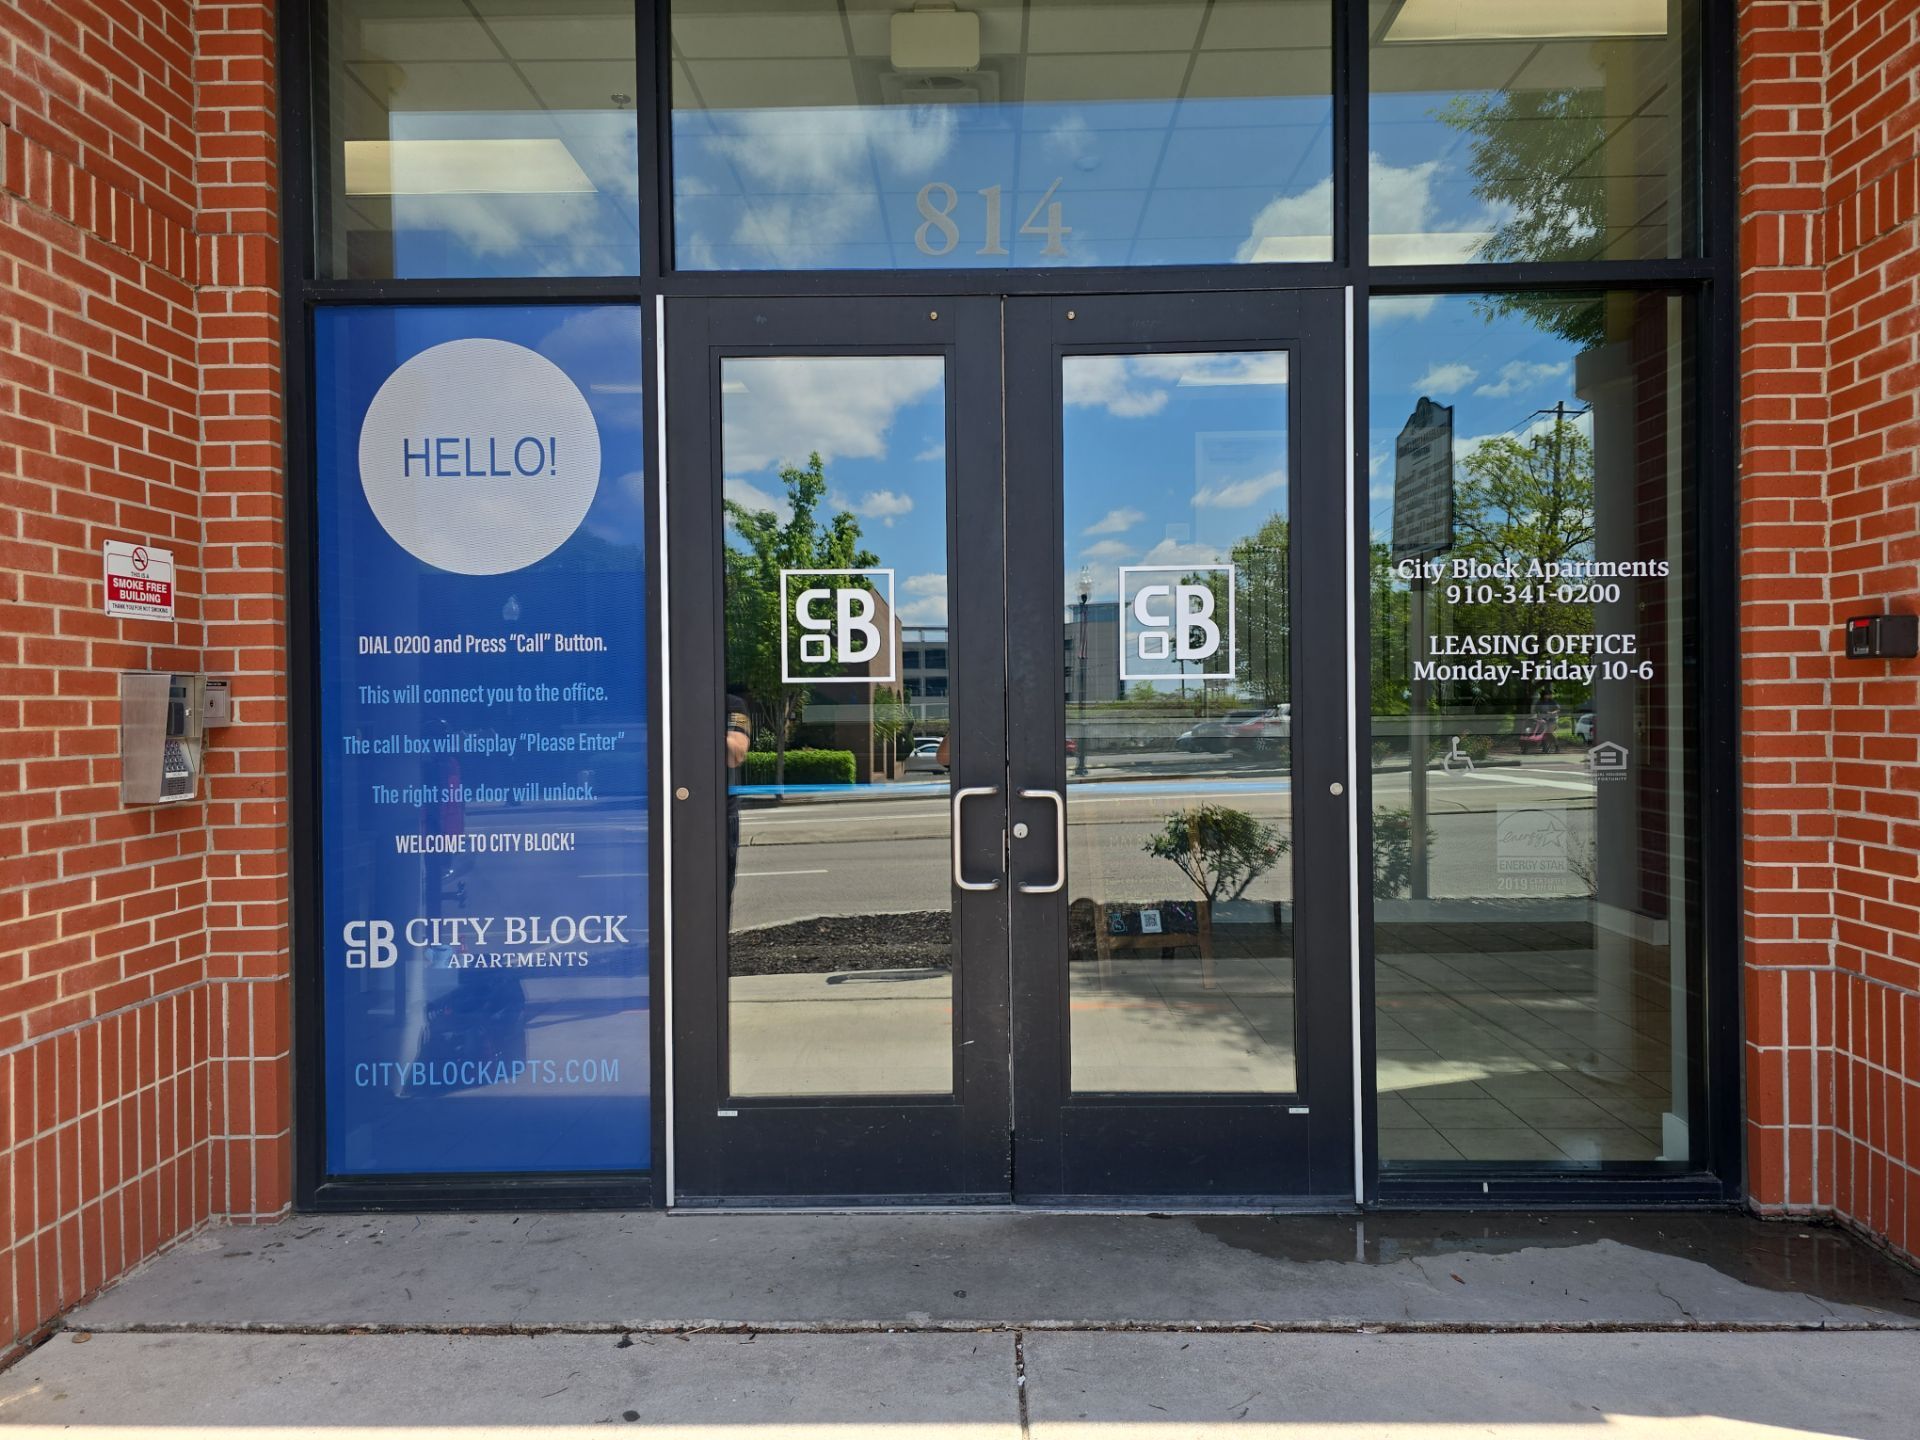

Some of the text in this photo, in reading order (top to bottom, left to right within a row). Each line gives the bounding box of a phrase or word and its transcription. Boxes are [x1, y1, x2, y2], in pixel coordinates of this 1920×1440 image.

[914, 176, 1072, 256] 814
[403, 436, 556, 478] HELLO!
[1400, 558, 1670, 583] City Block Apartments
[113, 577, 167, 594] SMOKE FREE
[120, 589, 161, 603] BUILDING
[1446, 584, 1620, 604] 910-341-0200
[359, 636, 391, 655] DIAL
[394, 635, 430, 654] 0200
[434, 634, 462, 653] and
[465, 634, 506, 653] Press
[555, 633, 607, 652] Button.
[1429, 634, 1637, 656] LEASING OFFICE
[1413, 659, 1654, 685] Monday-Friday 10-6
[358, 682, 608, 707] This will connect you to the office.
[343, 736, 370, 755] The
[373, 735, 400, 754] call
[404, 734, 430, 753] box
[433, 734, 460, 753] will
[463, 733, 517, 757] display
[372, 782, 598, 808] The right side door will unlock.
[395, 832, 575, 854] WELCOME TO CITY BLOCK!
[1500, 859, 1565, 871] ENERGY STAR
[1497, 877, 1528, 890] 2019
[405, 915, 629, 947] CITY BLOCK
[448, 951, 588, 969] APARTMENTS
[355, 1058, 619, 1087] CITYBLOCKAPTS.COM
